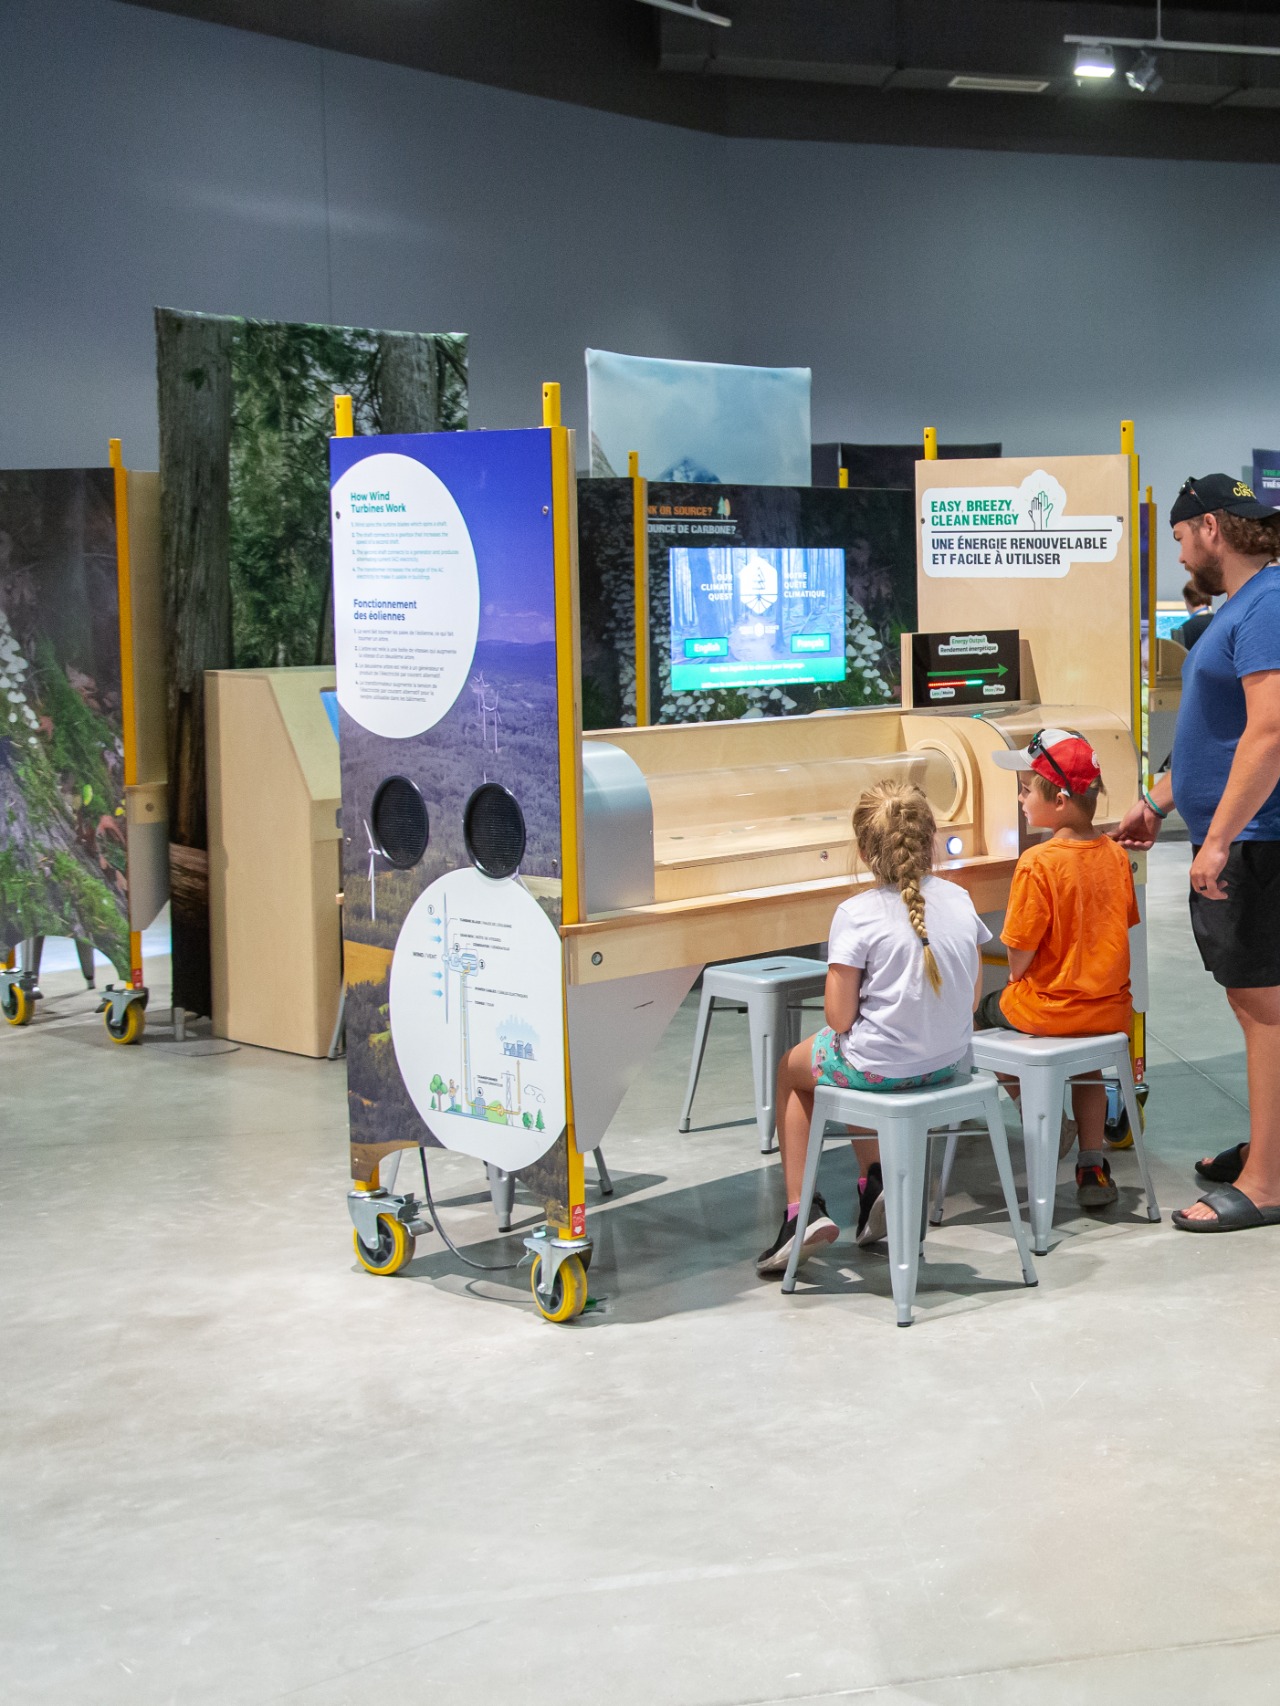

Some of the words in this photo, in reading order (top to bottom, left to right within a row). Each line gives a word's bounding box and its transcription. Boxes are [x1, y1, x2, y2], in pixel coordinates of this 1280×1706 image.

[350, 492, 368, 501] How
[369, 491, 390, 501] Wind
[351, 504, 384, 513] Turbines
[385, 503, 406, 512] Work
[930, 500, 963, 512] EASY,
[966, 499, 1014, 512] BREEZY,
[931, 514, 970, 526] CLEAN
[972, 513, 1019, 525] ENERGY
[648, 524, 676, 533] OURCE
[931, 538, 954, 550] UNE
[957, 535, 1007, 550] ÉNERGIE
[1010, 537, 1107, 549] RENOUVELABLE
[932, 553, 946, 564] ET
[949, 553, 991, 564] FACILE
[994, 549, 1003, 564] À
[1005, 552, 1060, 564] UTILISER
[354, 598, 417, 610] Fonctionnement
[354, 610, 367, 620] des
[368, 610, 405, 620] éoliennes
